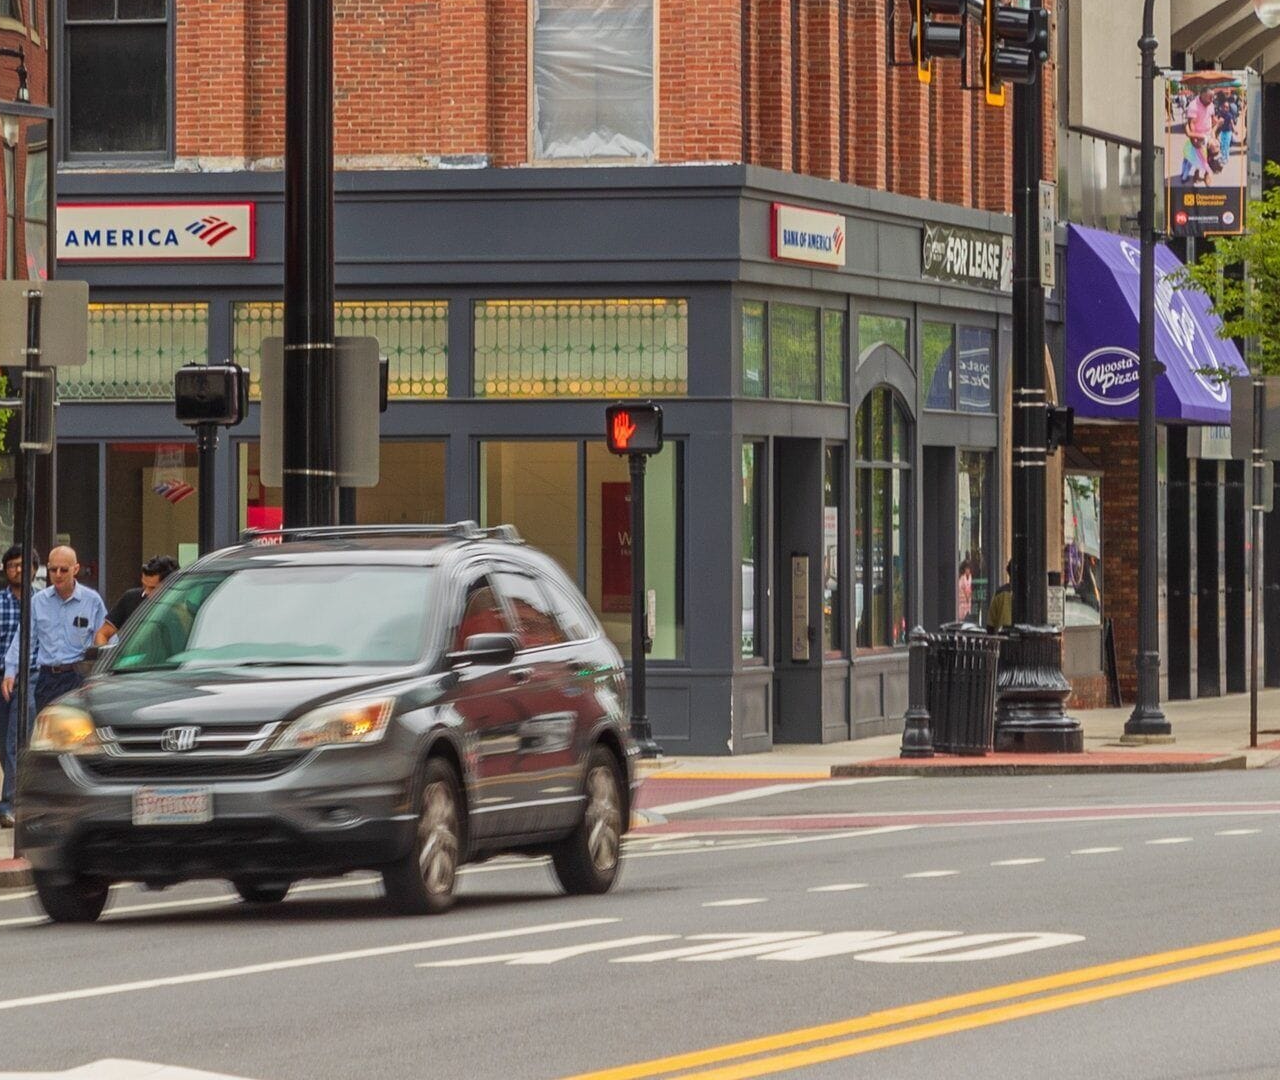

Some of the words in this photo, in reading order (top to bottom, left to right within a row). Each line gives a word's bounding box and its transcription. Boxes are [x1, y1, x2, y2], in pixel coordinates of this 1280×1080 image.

[65, 228, 180, 247] AMERICA
[783, 228, 799, 246] BANK
[800, 231, 807, 247] OF
[808, 233, 832, 252] AMERICA
[946, 235, 968, 276] FOR
[968, 239, 1000, 281] LEASE
[1086, 359, 1134, 387] Woosta
[1102, 370, 1140, 395] Pizza
[415, 930, 1087, 968] ONLY
